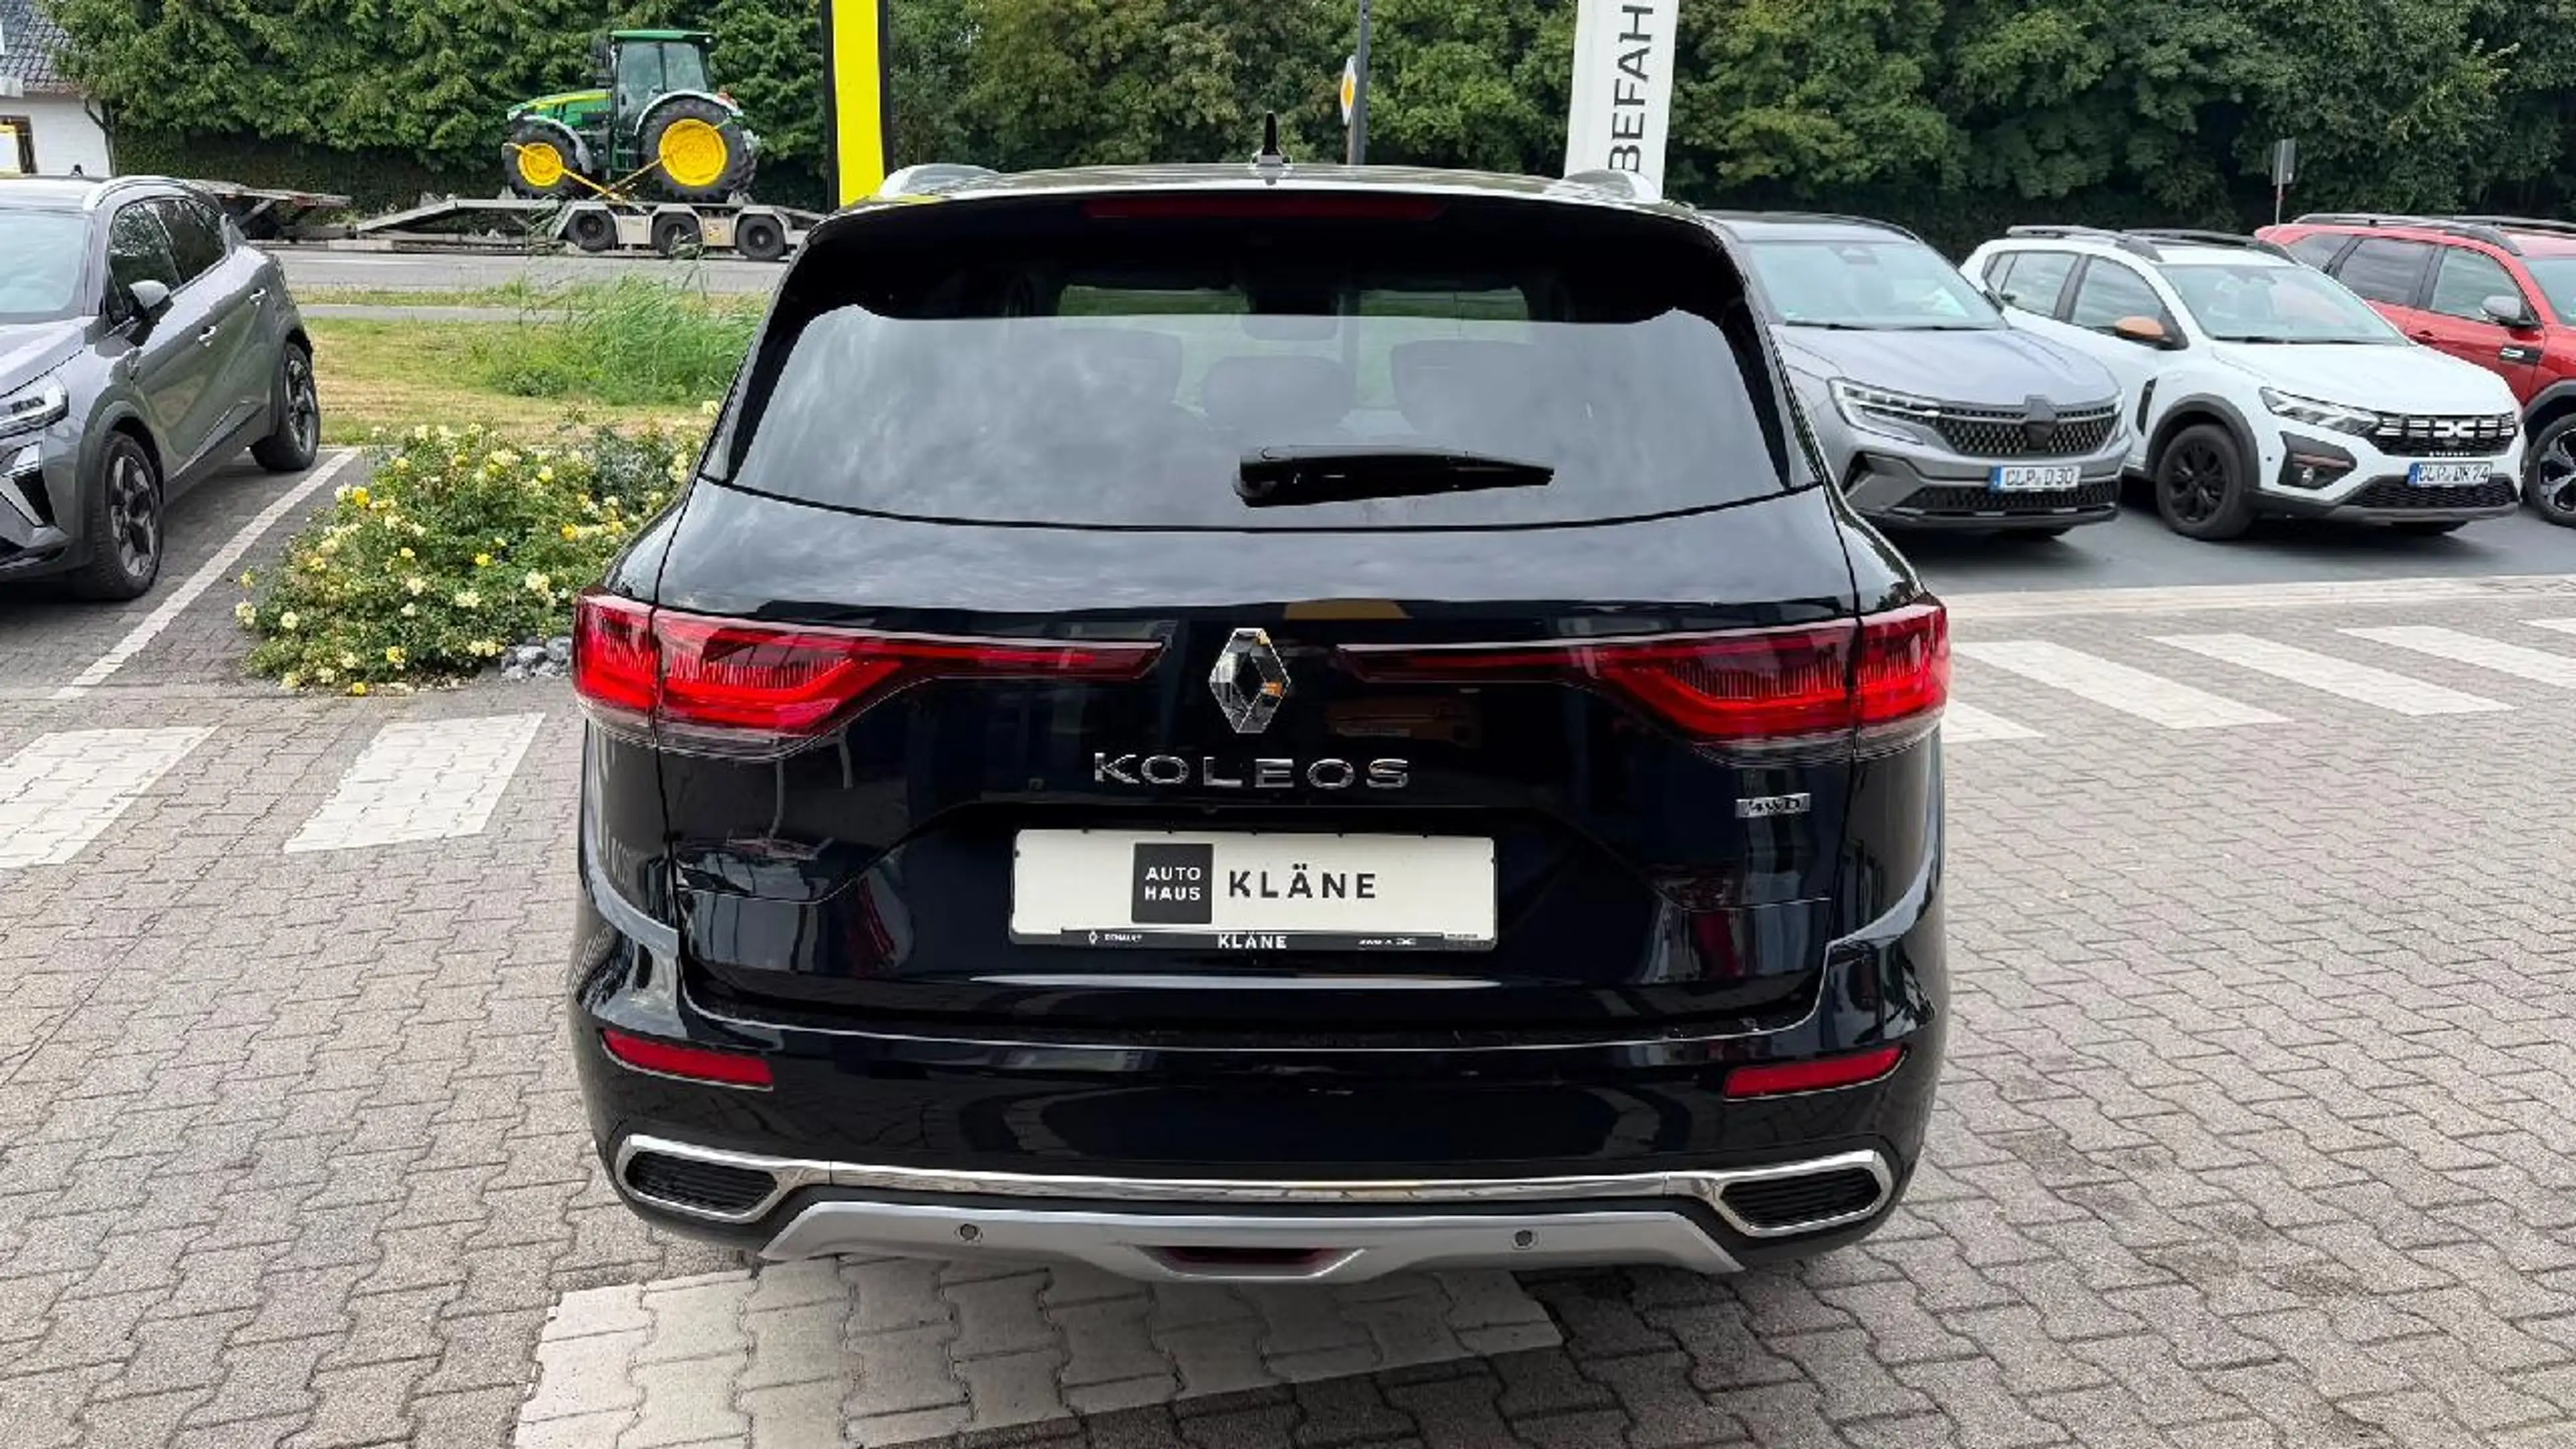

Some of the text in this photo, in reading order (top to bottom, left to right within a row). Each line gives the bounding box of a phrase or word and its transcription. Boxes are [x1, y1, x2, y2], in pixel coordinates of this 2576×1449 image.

[1094, 751, 1409, 788] KOLEOS
[1144, 866, 1201, 881] AUTO
[1228, 863, 1377, 899] KLÄNE
[1144, 885, 1201, 902] HAUS
[1217, 930, 1288, 949] KLÄNE
